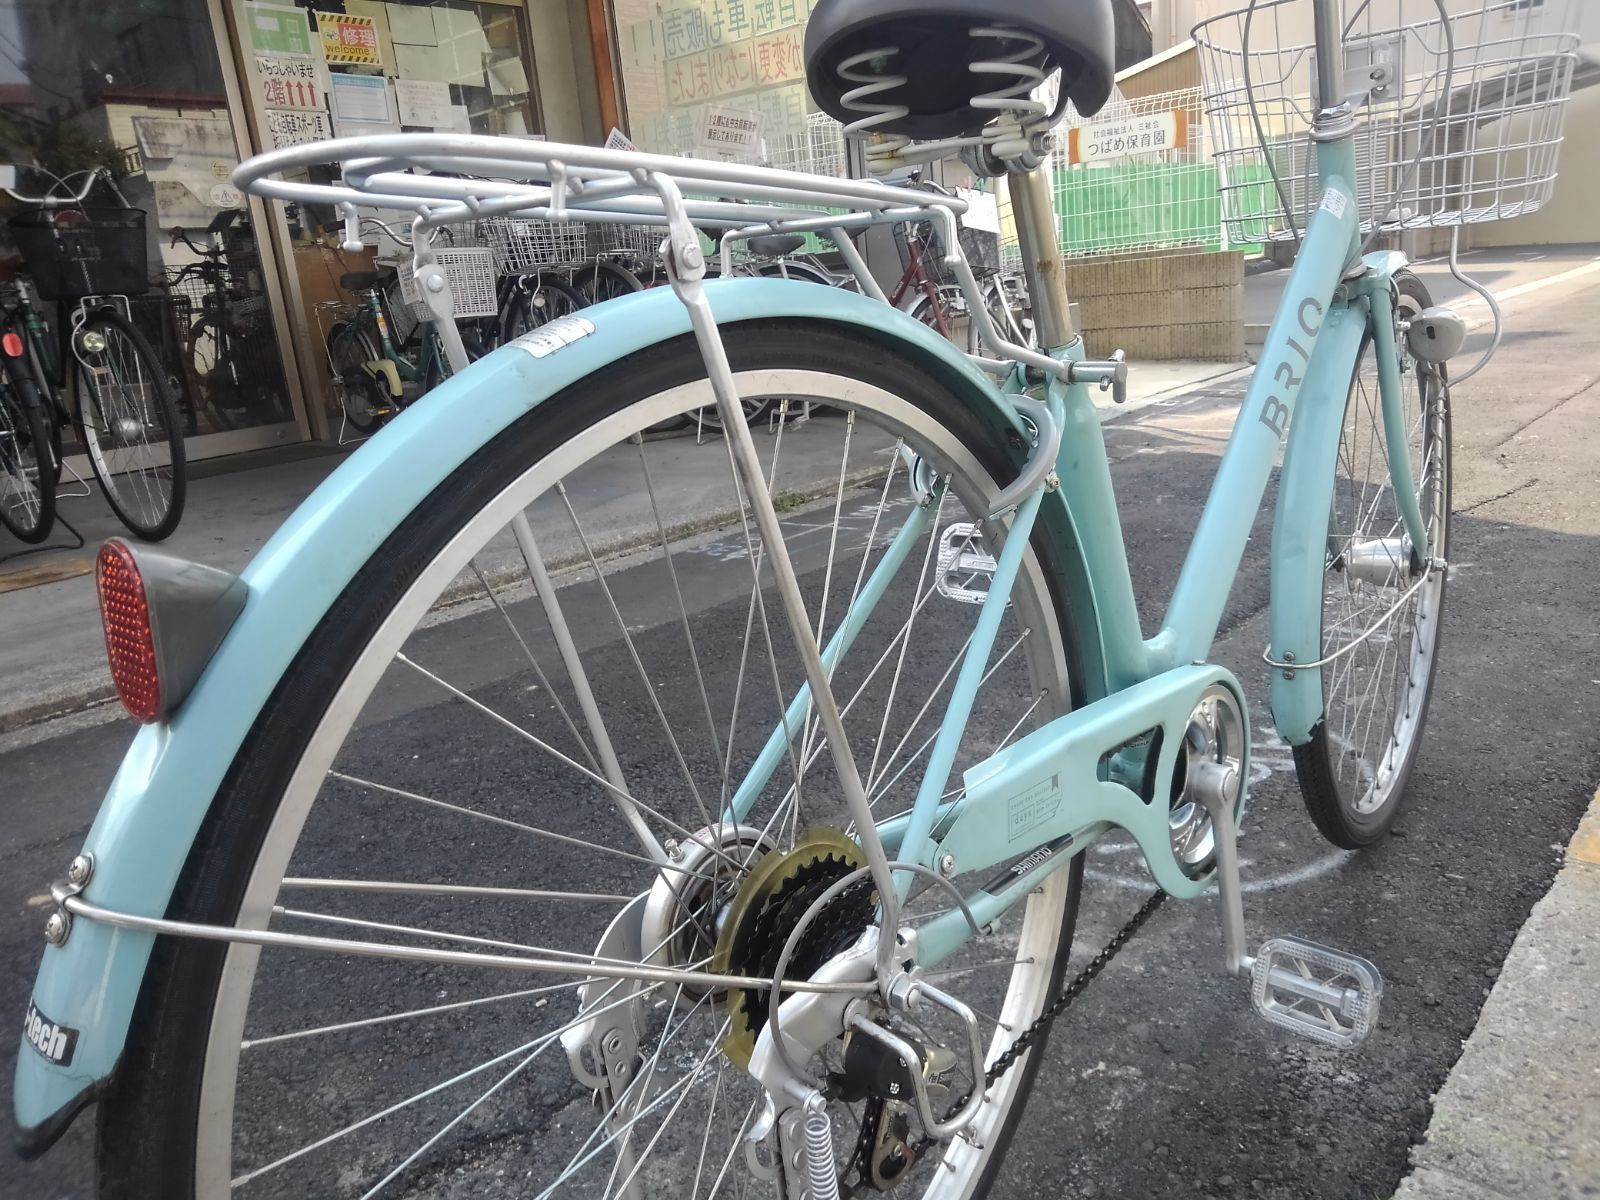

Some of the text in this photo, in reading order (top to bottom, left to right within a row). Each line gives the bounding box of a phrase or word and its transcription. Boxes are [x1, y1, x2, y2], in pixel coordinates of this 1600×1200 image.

[343, 26, 376, 47] 修理
[325, 45, 370, 56] welcome
[257, 59, 314, 78] いらっしゃいませ
[264, 78, 286, 105] 2階
[1087, 129, 1165, 156] つばめ保育園
[1010, 847, 1053, 875] SHIMANO
